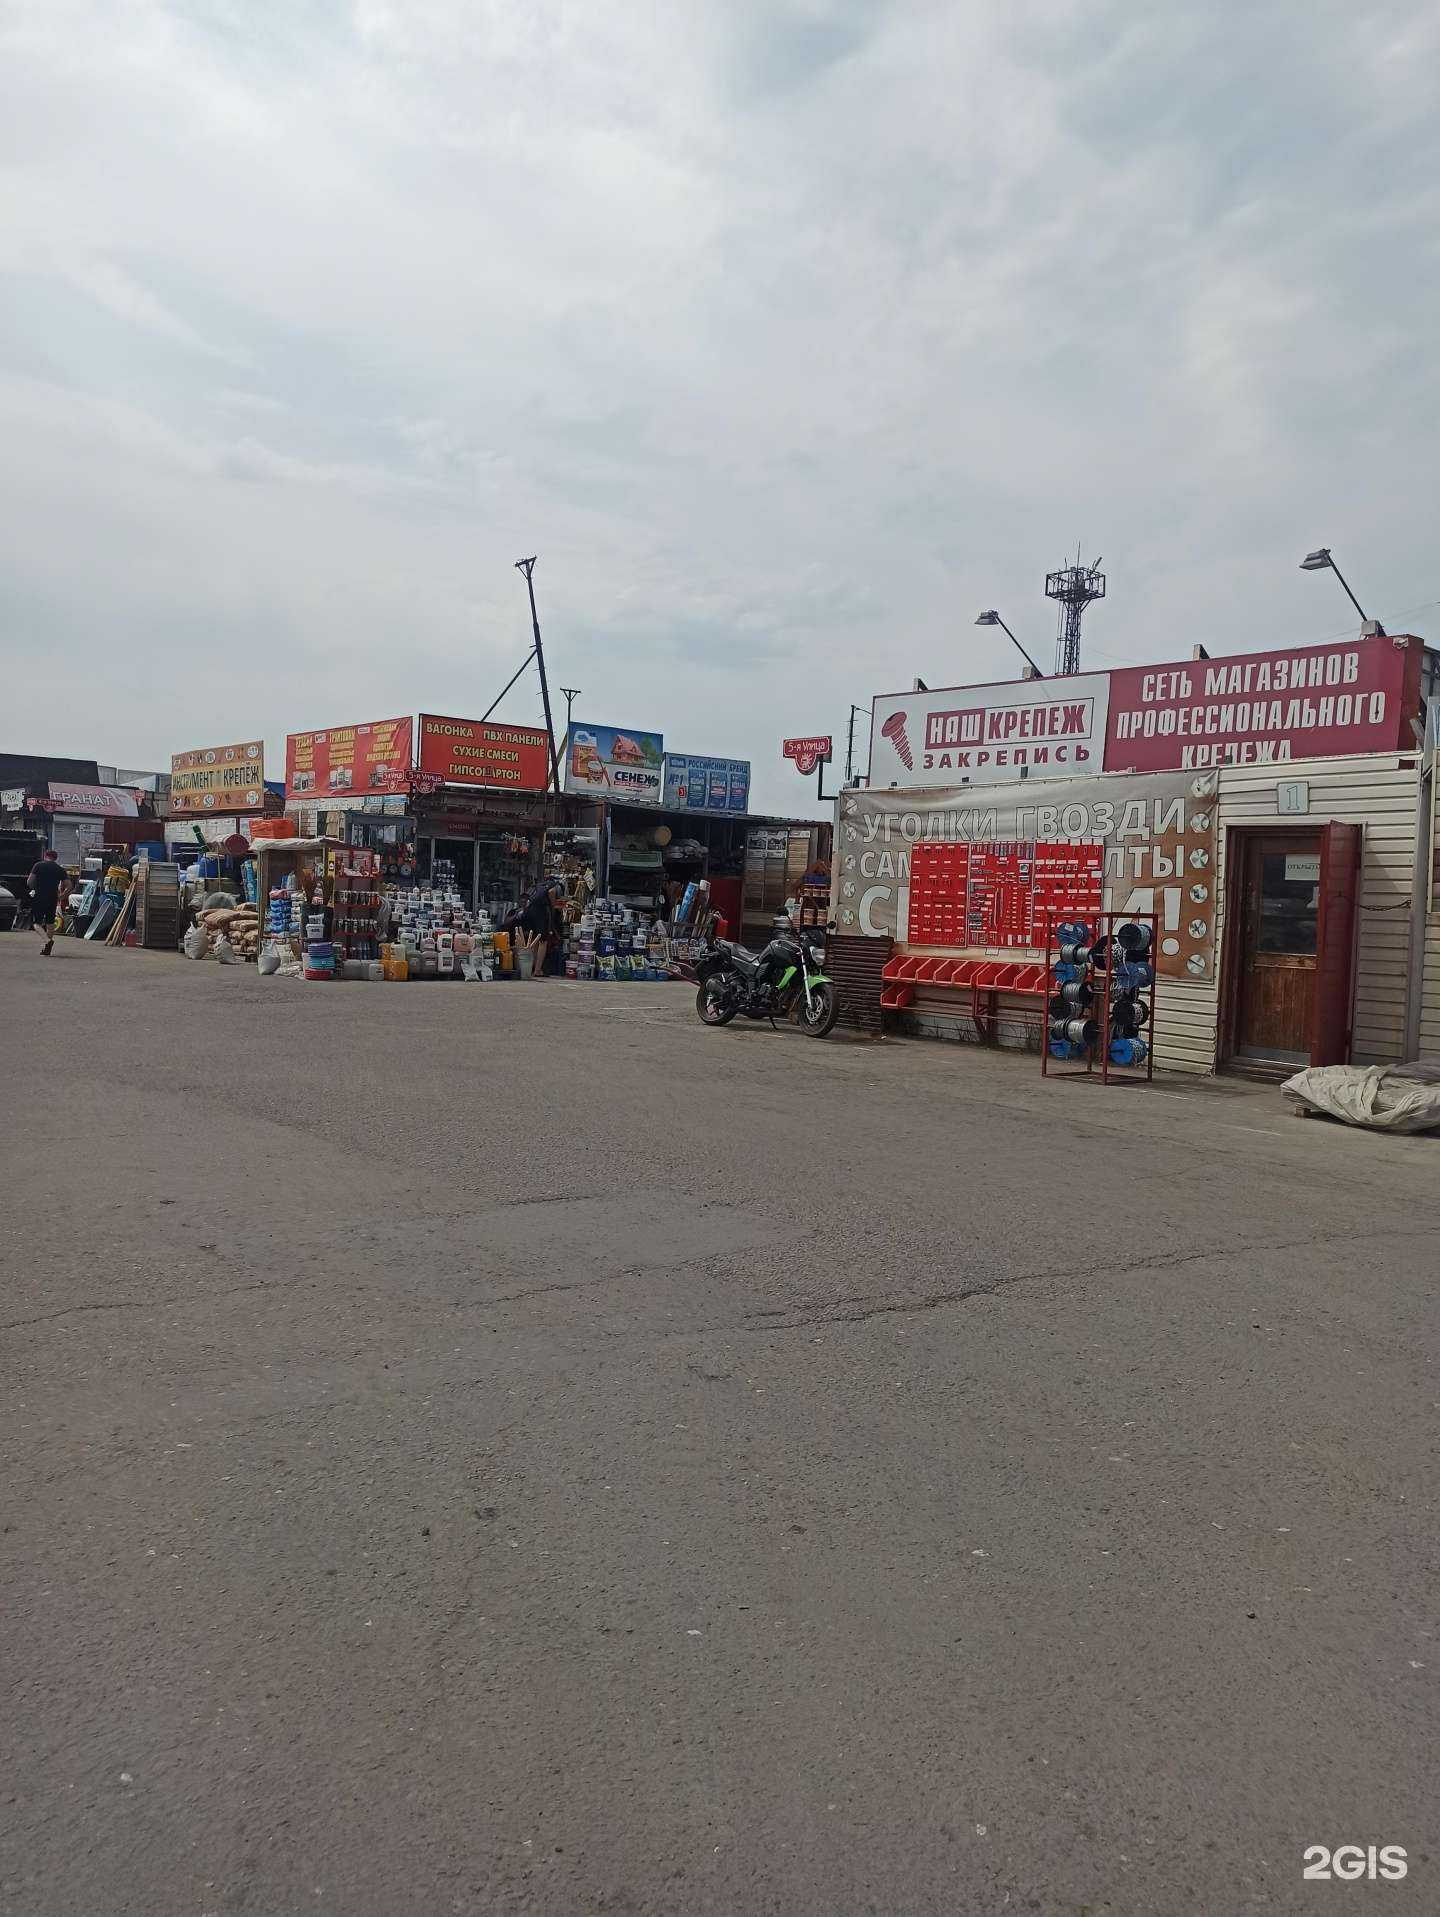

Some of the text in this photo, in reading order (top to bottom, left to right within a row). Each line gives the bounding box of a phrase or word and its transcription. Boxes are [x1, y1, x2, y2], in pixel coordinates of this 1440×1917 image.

[1142, 652, 1360, 703] СЕТЬ МАГАЗИНОВ
[930, 704, 1087, 744] НАШ КРЕПЕЖ
[1115, 691, 1387, 740] ПРОФЕССИОНАЛЬНОГО
[426, 721, 544, 747] ВАГОНКА ПВХ ПАНЕЛИ
[452, 745, 520, 762] СУХИЕ СМЕСИ
[922, 744, 1091, 770] ЗАКРЕПИСЬ
[613, 770, 652, 787] СЕНЕЖ
[53, 791, 114, 806] ГРАНАТ
[1286, 785, 1299, 811] 1
[861, 798, 1186, 847] УГОЛКИ ГВОЗДИ
